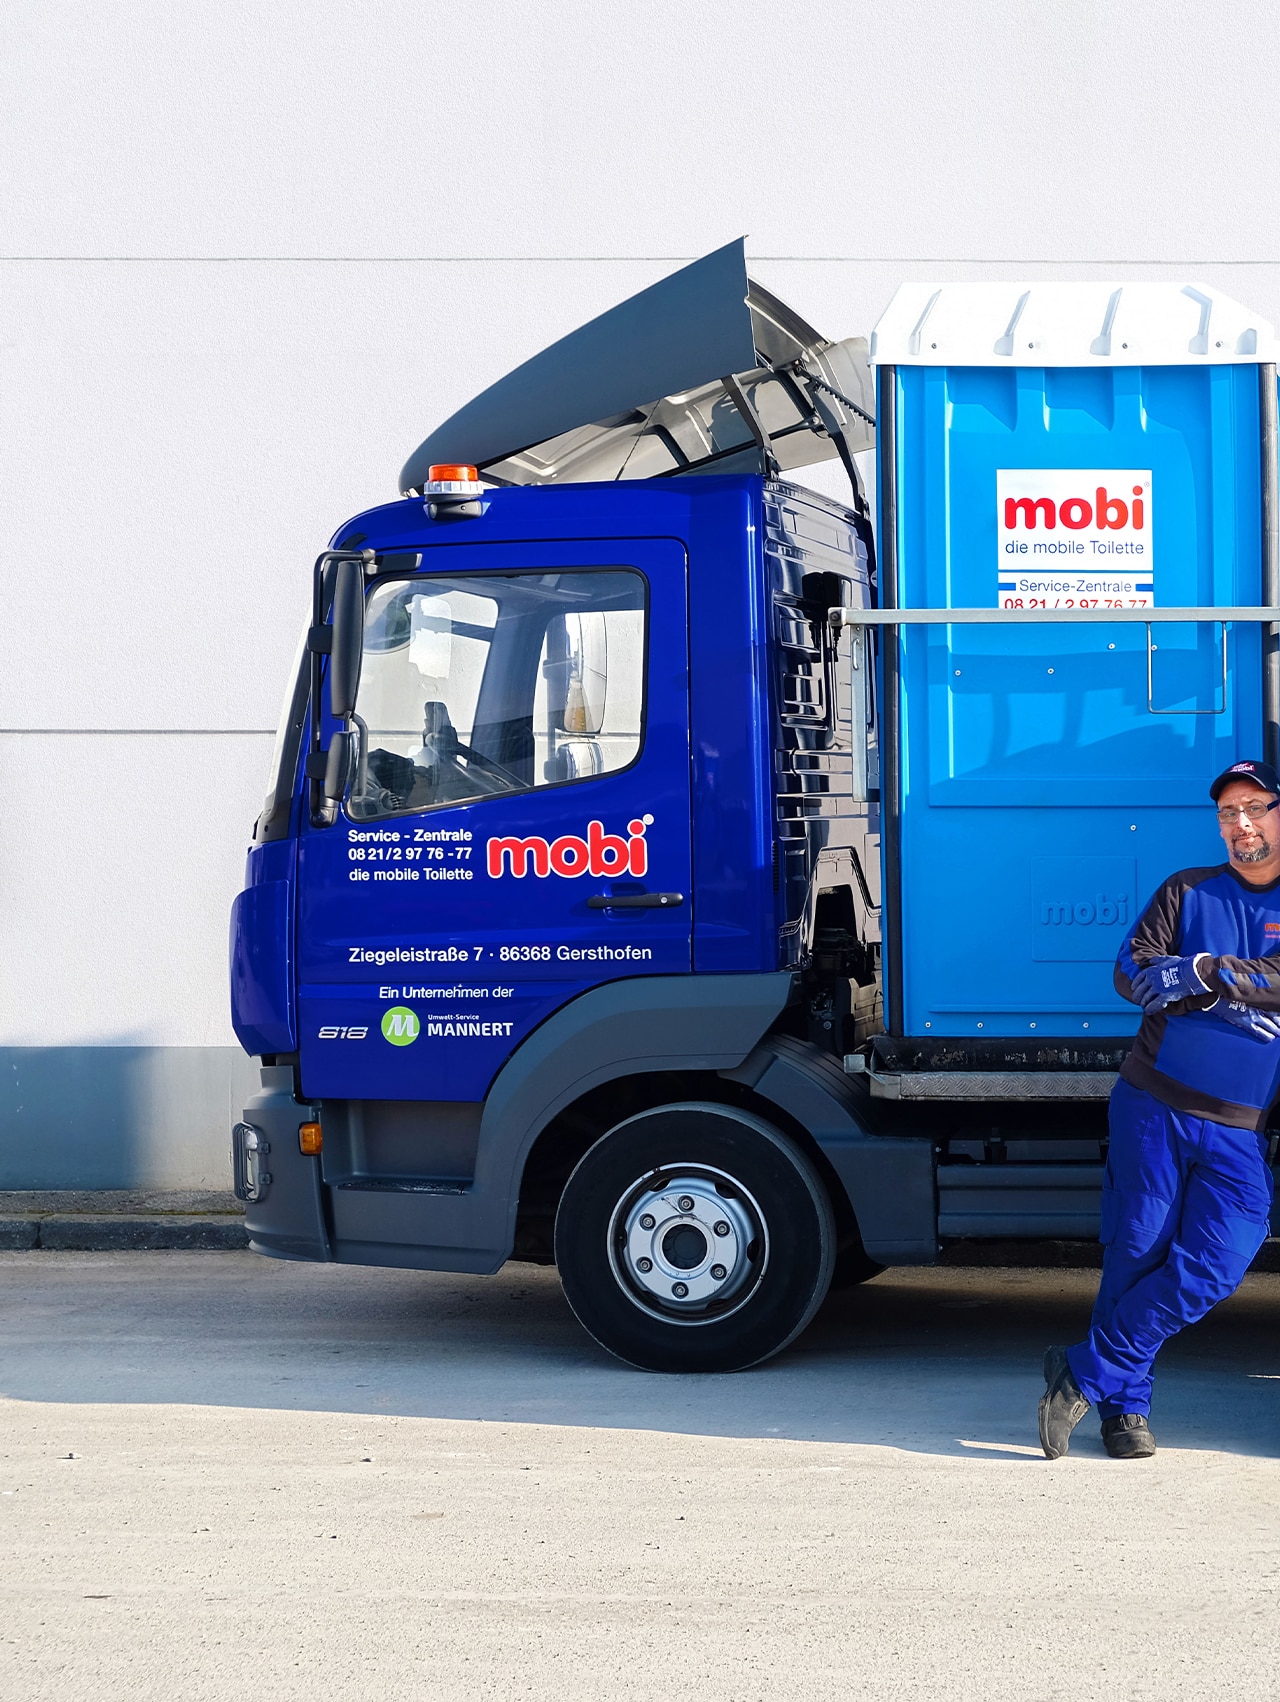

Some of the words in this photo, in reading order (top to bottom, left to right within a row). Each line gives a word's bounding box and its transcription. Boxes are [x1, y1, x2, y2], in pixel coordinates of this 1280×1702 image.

[1004, 485, 1144, 530] mobi
[1005, 540, 1029, 554] die
[1033, 540, 1085, 555] mobile
[1089, 540, 1145, 555] Toilette
[1019, 579, 1132, 593] Service-Zentrale
[1004, 598, 1024, 608] 08
[1029, 598, 1046, 608] 21
[1079, 598, 1098, 608] 97
[1104, 599, 1123, 608] 76
[1128, 599, 1148, 608] 77
[348, 829, 401, 842] Service
[413, 828, 473, 842] Zentrale
[405, 847, 423, 860] 97
[426, 847, 444, 860] 76
[487, 819, 647, 878] mobi
[349, 868, 370, 881] die
[373, 868, 420, 881] mobile
[423, 867, 473, 881] Toilette
[1041, 893, 1128, 926] mobi
[348, 946, 469, 965] Ziegeleistraße
[473, 947, 484, 962] 7
[499, 946, 551, 962] 86368
[556, 945, 652, 961] Gersthofen
[379, 986, 399, 999] Ein
[402, 985, 488, 999] Unternehmen
[492, 985, 514, 998] der
[427, 1013, 480, 1021] Umwelt-Service
[427, 1022, 514, 1037] MANNERT
